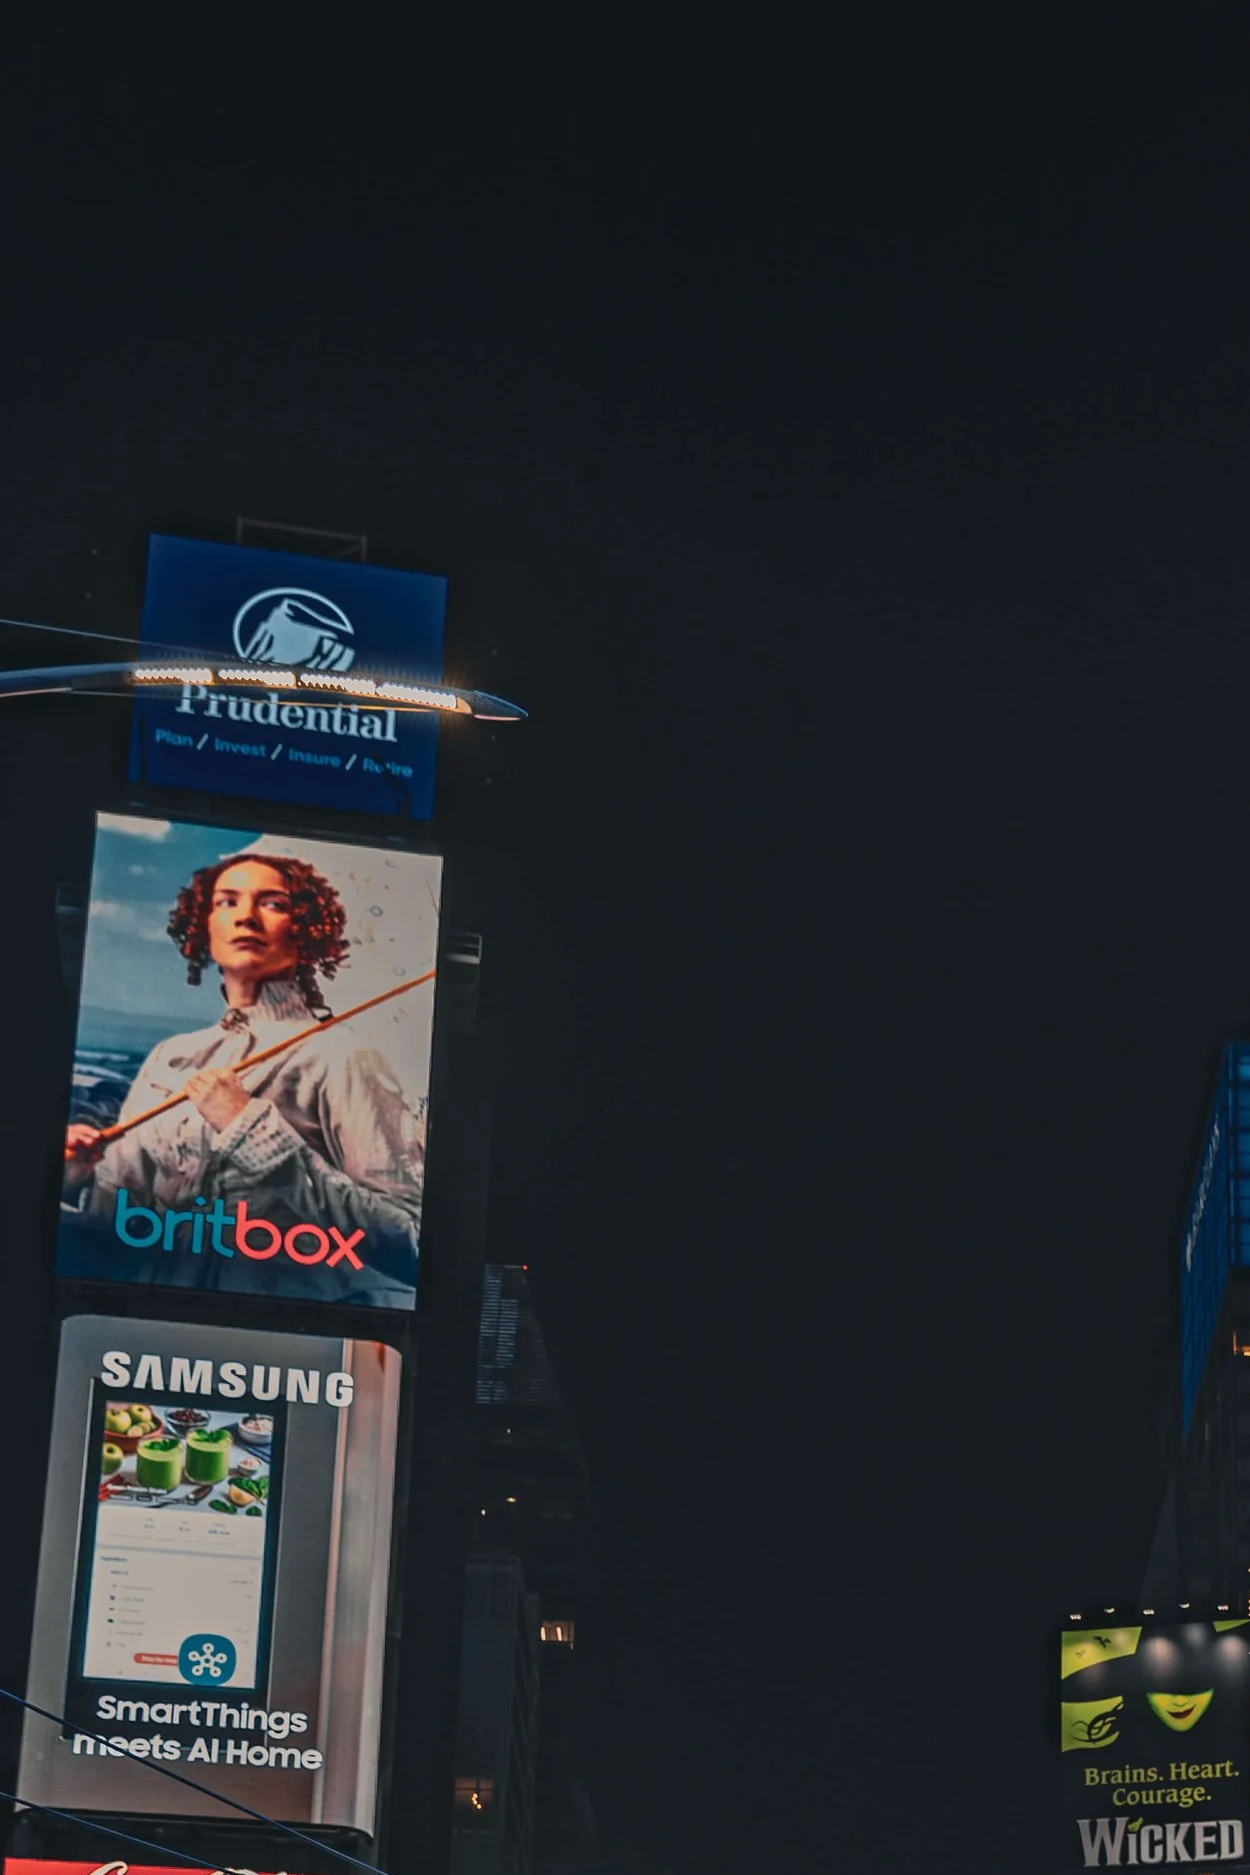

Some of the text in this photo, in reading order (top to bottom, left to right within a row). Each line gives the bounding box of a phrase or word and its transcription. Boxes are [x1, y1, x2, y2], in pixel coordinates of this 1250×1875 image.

[174, 682, 398, 743] Prudential
[154, 727, 194, 747] Plan
[213, 736, 267, 758] Invest
[288, 748, 341, 768] Insure
[114, 1187, 367, 1272] britbox
[100, 1350, 355, 1408] SAMSUNG
[95, 1694, 309, 1740] SmartThings
[72, 1732, 324, 1771] meets AI Home
[1084, 1759, 1241, 1787] Brains. Heart.
[1111, 1785, 1213, 1809] Courage.
